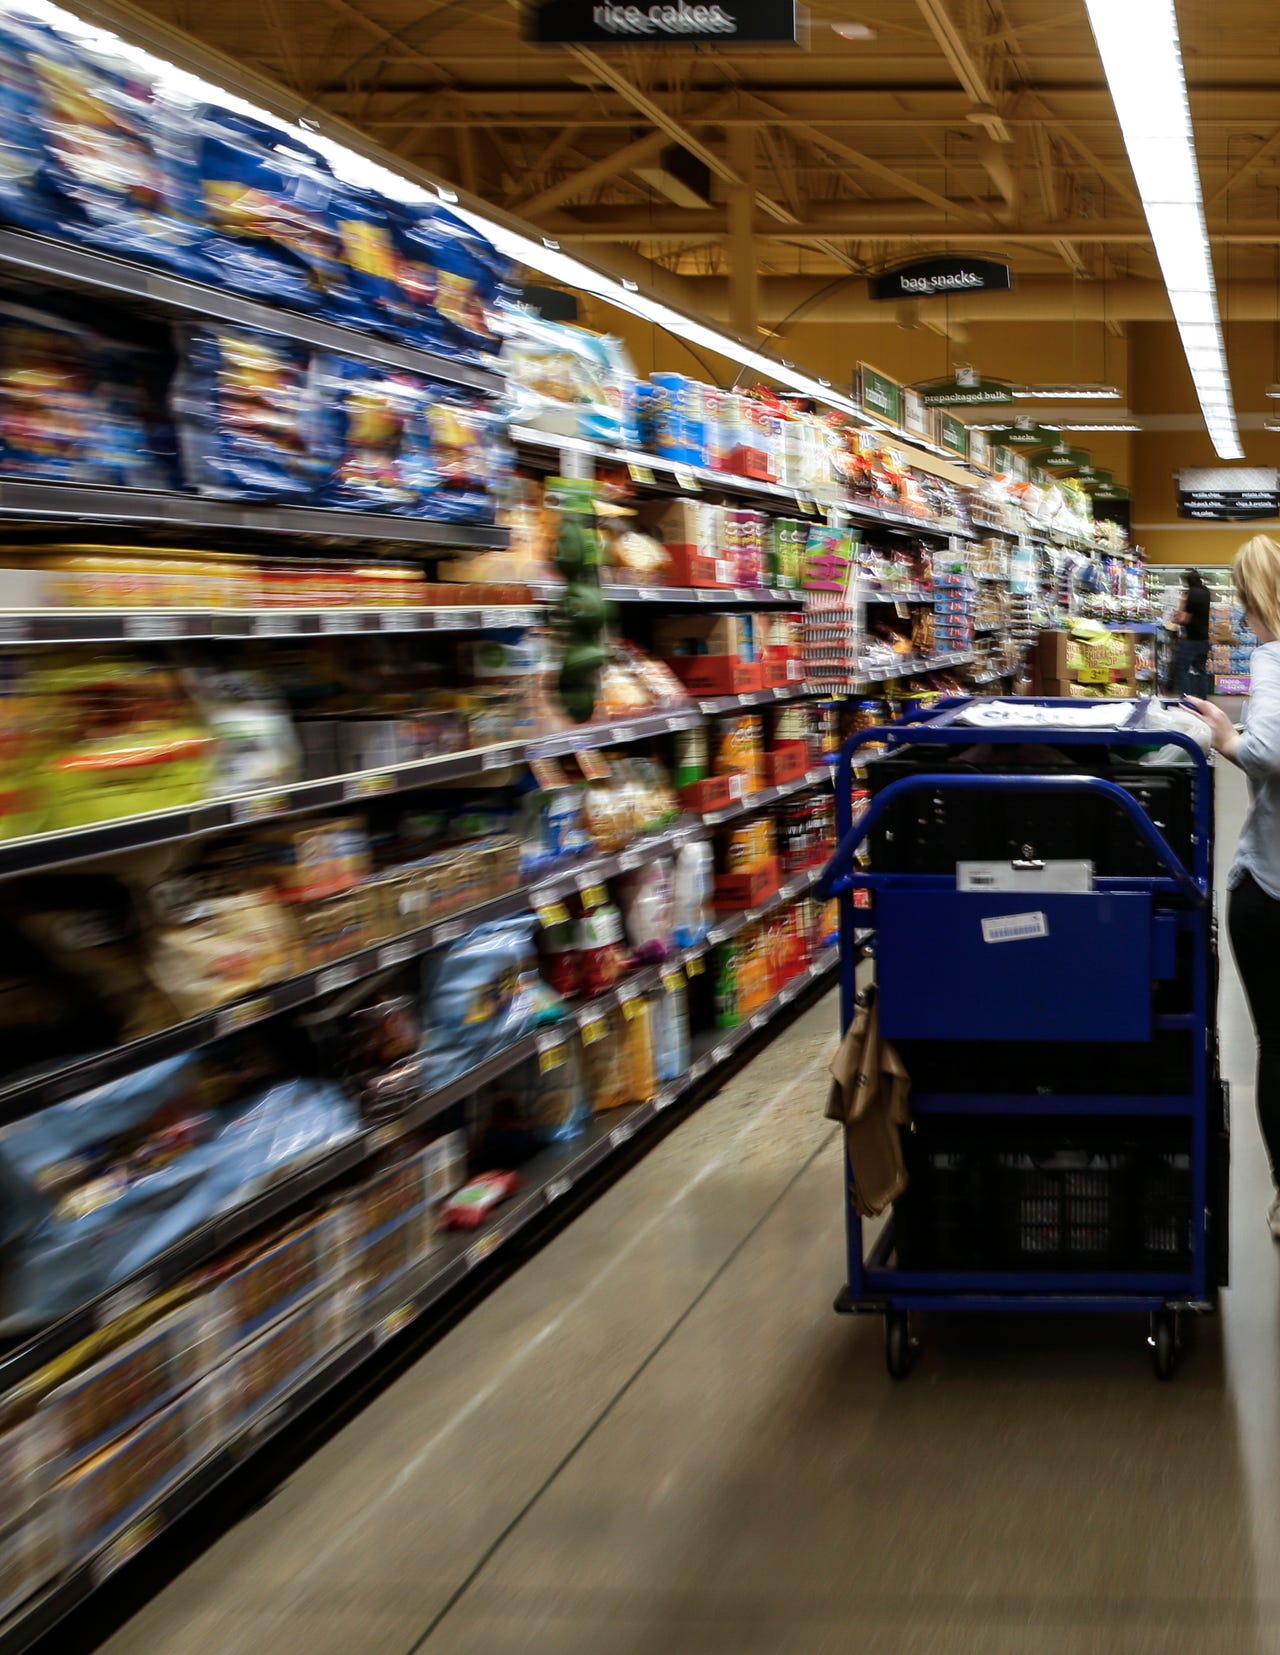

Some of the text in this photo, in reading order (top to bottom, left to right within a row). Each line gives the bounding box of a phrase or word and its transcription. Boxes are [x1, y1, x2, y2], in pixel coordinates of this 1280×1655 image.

[592, 0, 738, 34] rice cakes
[900, 270, 985, 294] bag snacks
[923, 391, 1011, 404] prepackaged bulk
[1008, 433, 1041, 443] snacks
